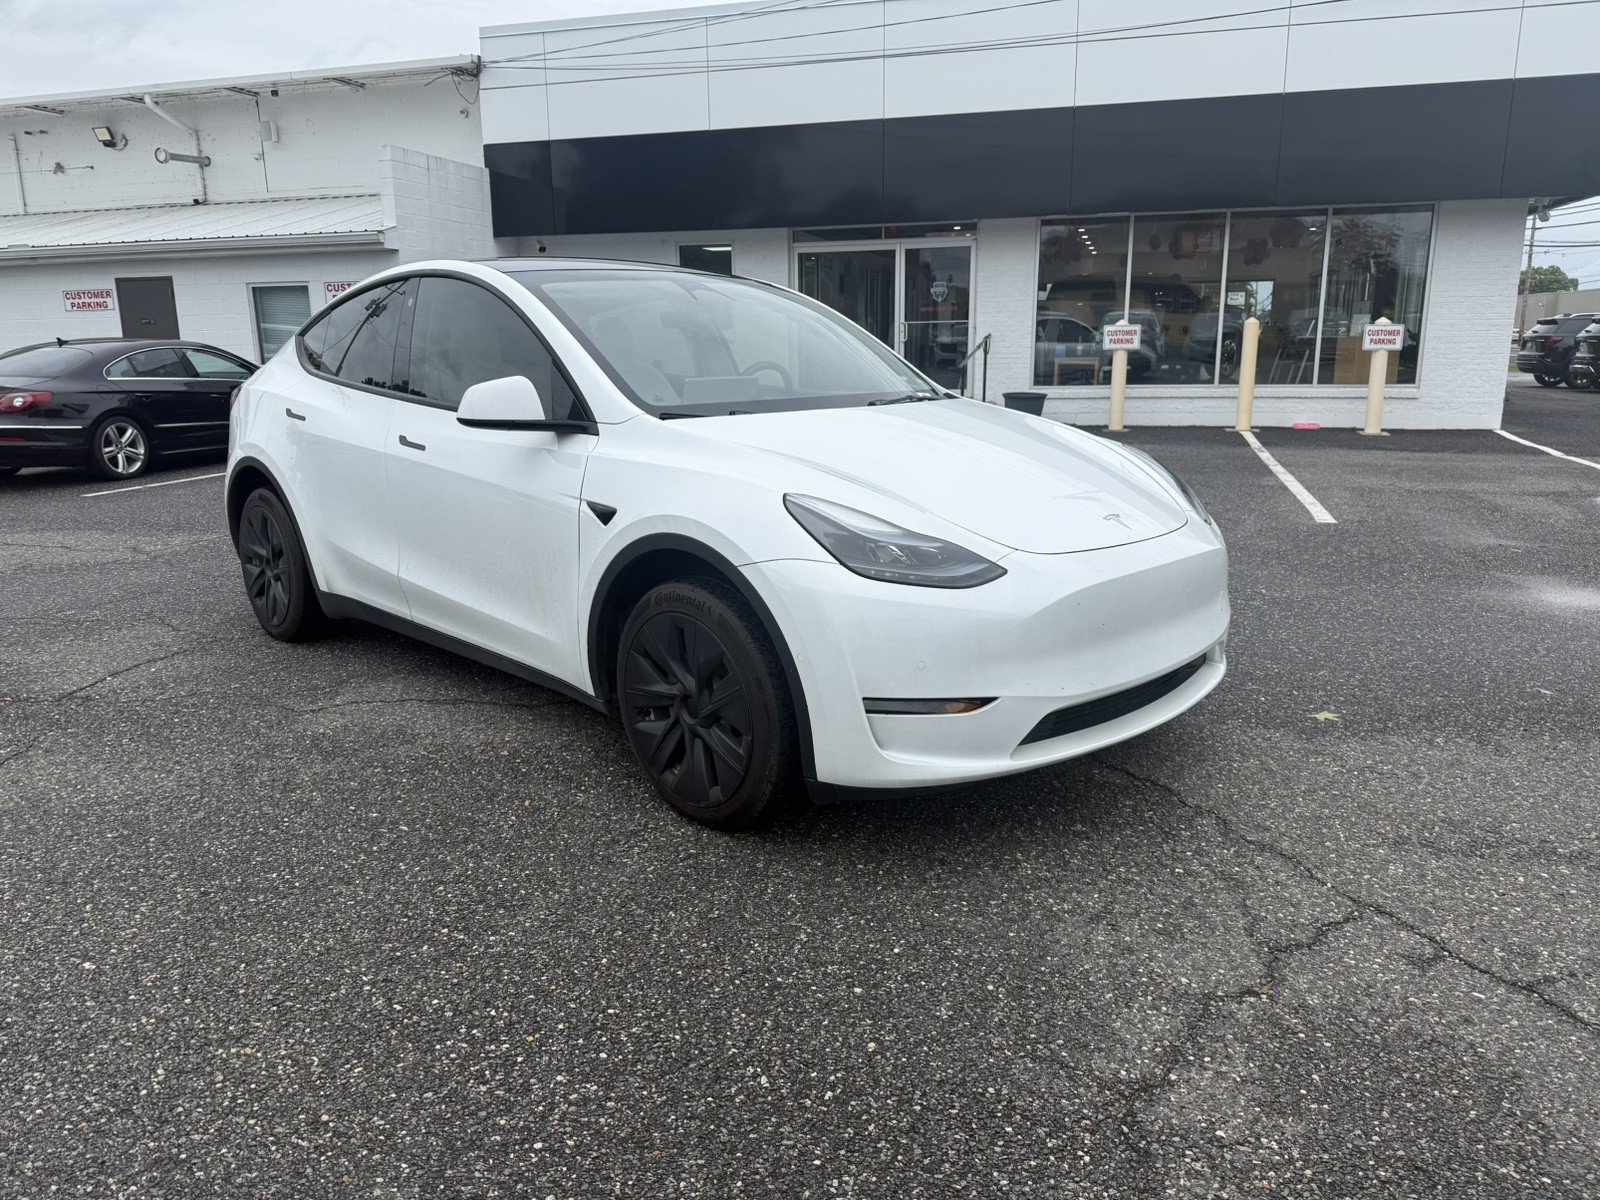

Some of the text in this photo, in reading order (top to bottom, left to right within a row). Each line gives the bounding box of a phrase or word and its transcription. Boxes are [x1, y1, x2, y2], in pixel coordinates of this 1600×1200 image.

[65, 290, 112, 300] CUSTOMER
[70, 301, 108, 310] PARKING
[1367, 329, 1401, 337] CUSTOMER
[655, 591, 706, 613] Continental
